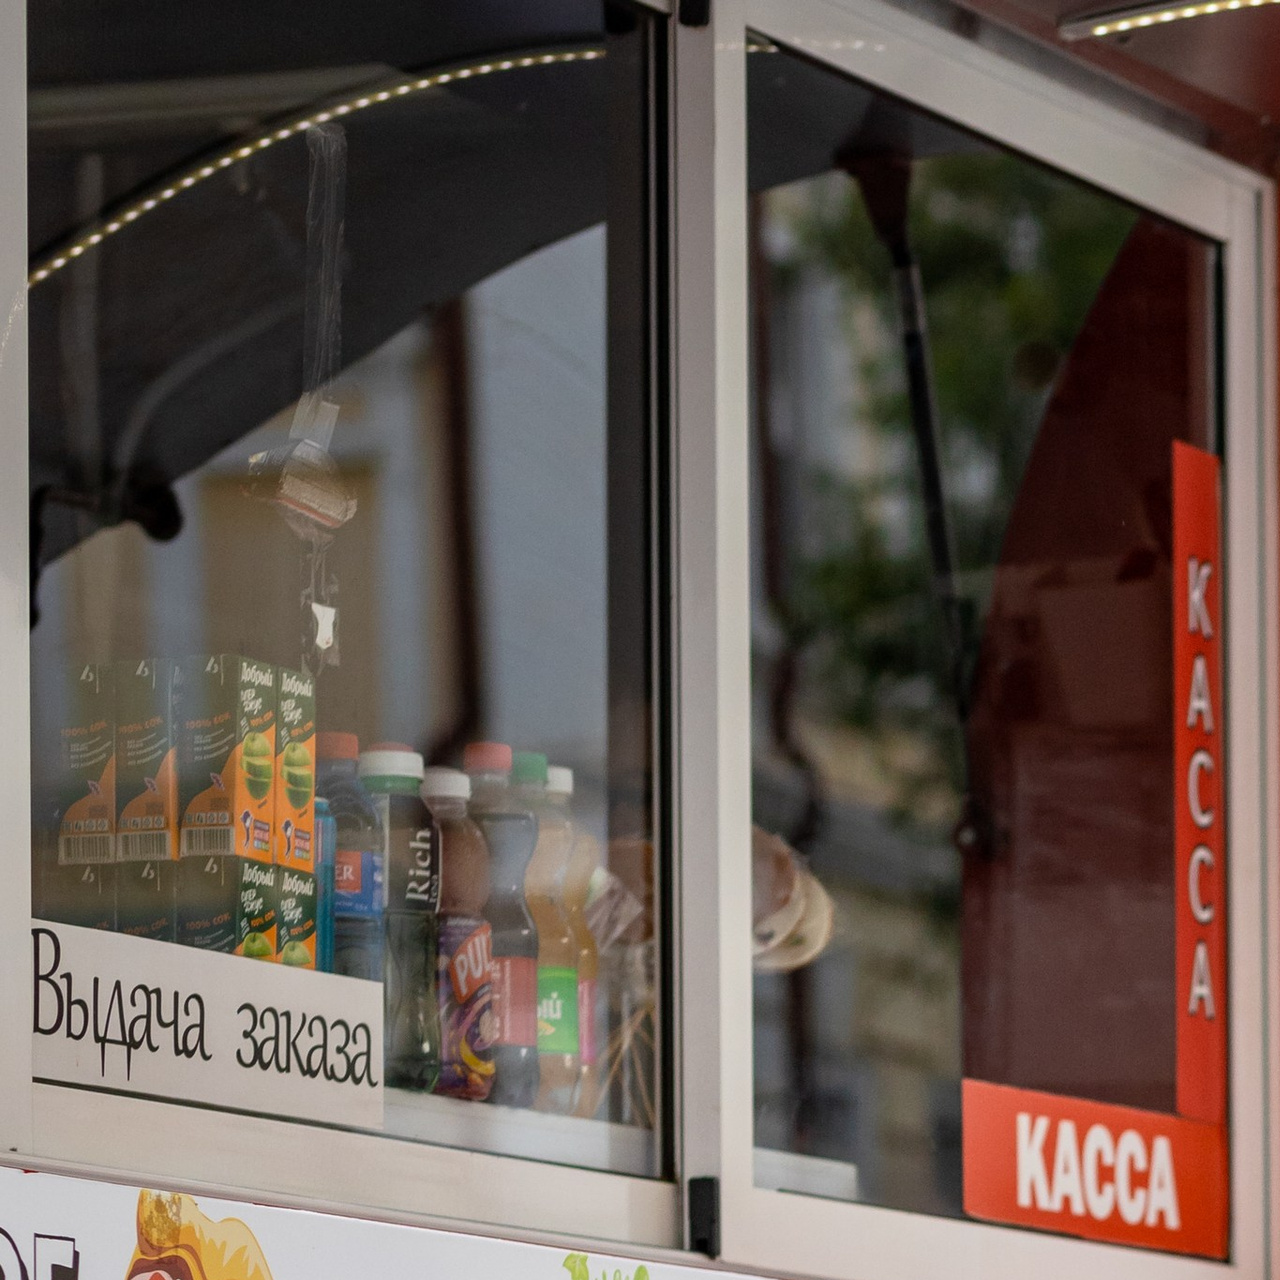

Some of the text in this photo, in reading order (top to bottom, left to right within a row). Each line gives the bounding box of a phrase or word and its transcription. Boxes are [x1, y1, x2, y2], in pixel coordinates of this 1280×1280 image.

[241, 661, 273, 688] Добрый
[281, 671, 313, 698] Добрый
[1187, 556, 1215, 1020] КАССА
[242, 862, 275, 888] Добрый
[282, 871, 316, 897] Добрый
[404, 827, 431, 901] Rich
[31, 927, 378, 1087] Выдача заказа
[1015, 1111, 1180, 1231] КАССА
